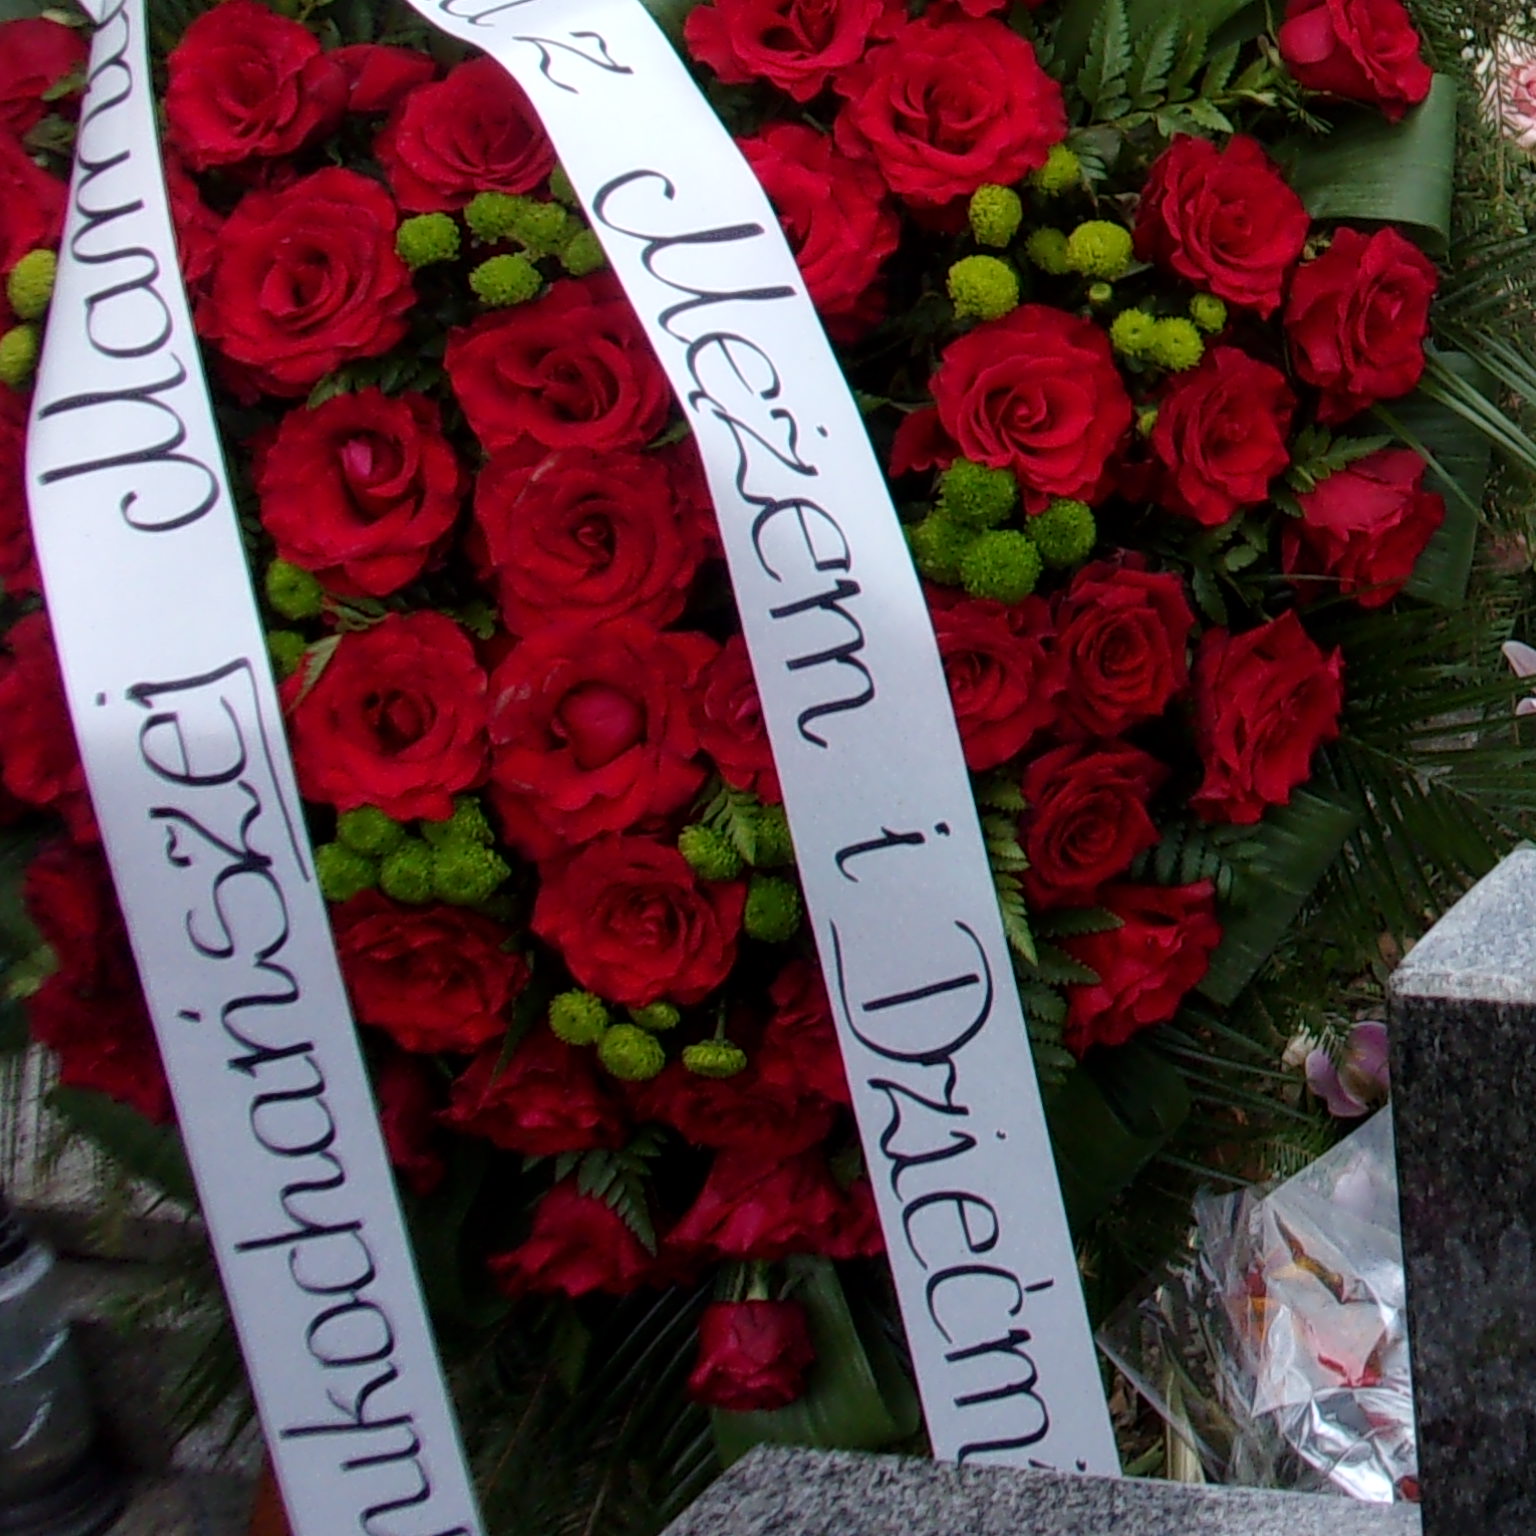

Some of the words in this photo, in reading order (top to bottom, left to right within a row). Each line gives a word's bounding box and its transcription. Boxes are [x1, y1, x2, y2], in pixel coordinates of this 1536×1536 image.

[511, 31, 634, 95] z
[834, 831, 952, 884] i
[95, 658, 468, 1536] ukochańszej
